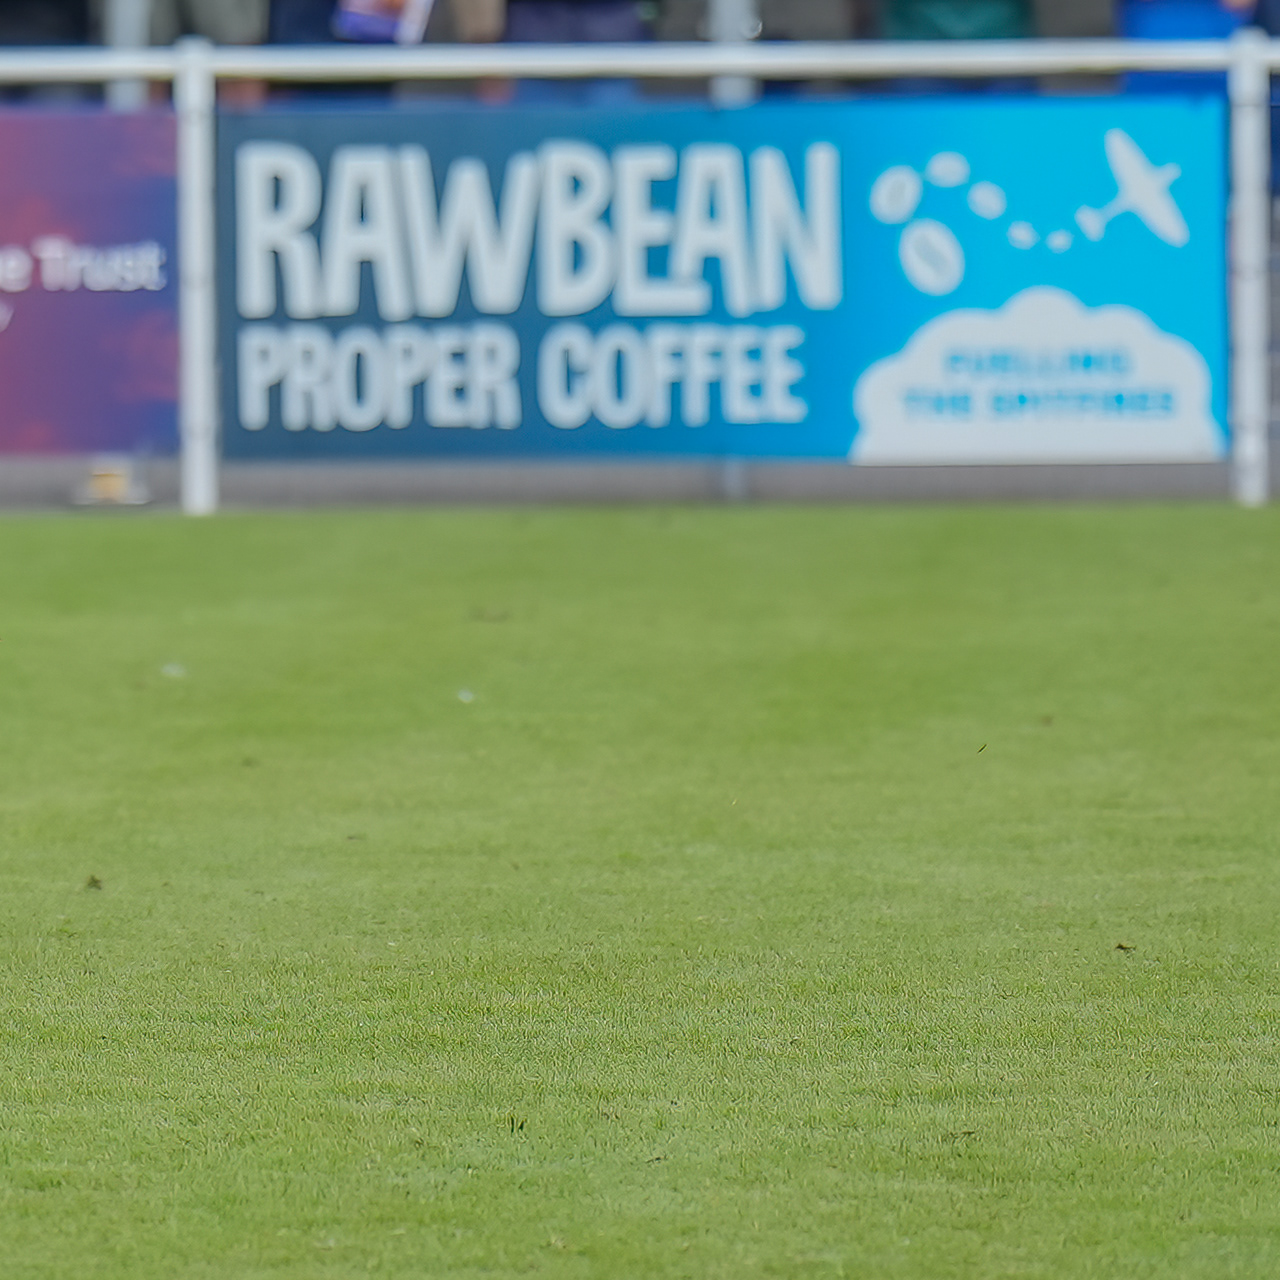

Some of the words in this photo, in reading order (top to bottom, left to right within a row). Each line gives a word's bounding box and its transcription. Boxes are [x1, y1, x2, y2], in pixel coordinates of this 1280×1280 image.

[31, 235, 166, 291] Trust
[235, 137, 842, 319] RAWBEAN
[238, 323, 523, 432] PROPER
[538, 323, 809, 429] COFFEE
